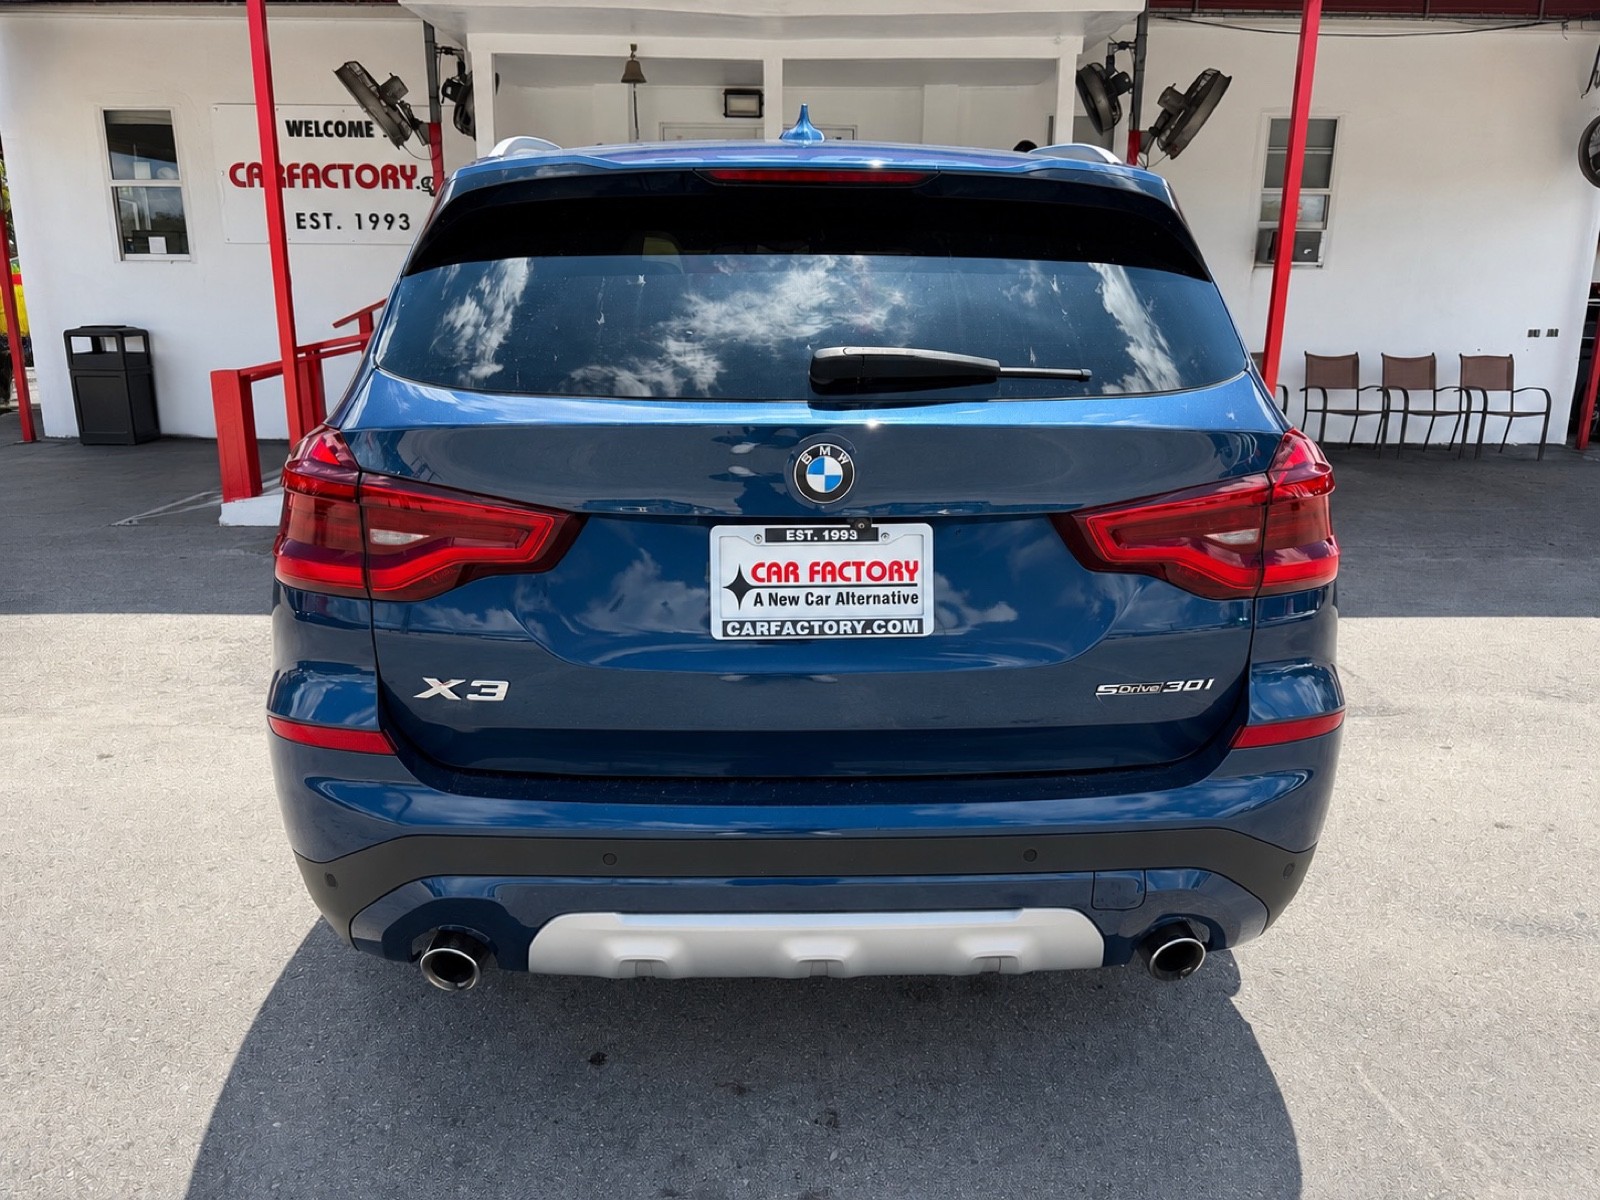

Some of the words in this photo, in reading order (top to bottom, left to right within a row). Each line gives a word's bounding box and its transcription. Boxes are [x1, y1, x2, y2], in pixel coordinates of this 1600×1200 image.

[285, 120, 375, 138] WELCOME
[295, 213, 342, 230] EST.
[355, 213, 411, 231] 1993
[801, 445, 849, 465] BMW
[786, 529, 818, 541] EST.
[822, 529, 858, 541] 1993
[751, 561, 800, 583] CAR
[809, 560, 919, 583] FACTORY
[753, 592, 764, 607] A
[768, 592, 800, 607] New
[805, 592, 831, 606] Car
[835, 591, 919, 606] Alternative
[726, 620, 919, 636] CARFACTORY.COM
[413, 677, 510, 701] X3
